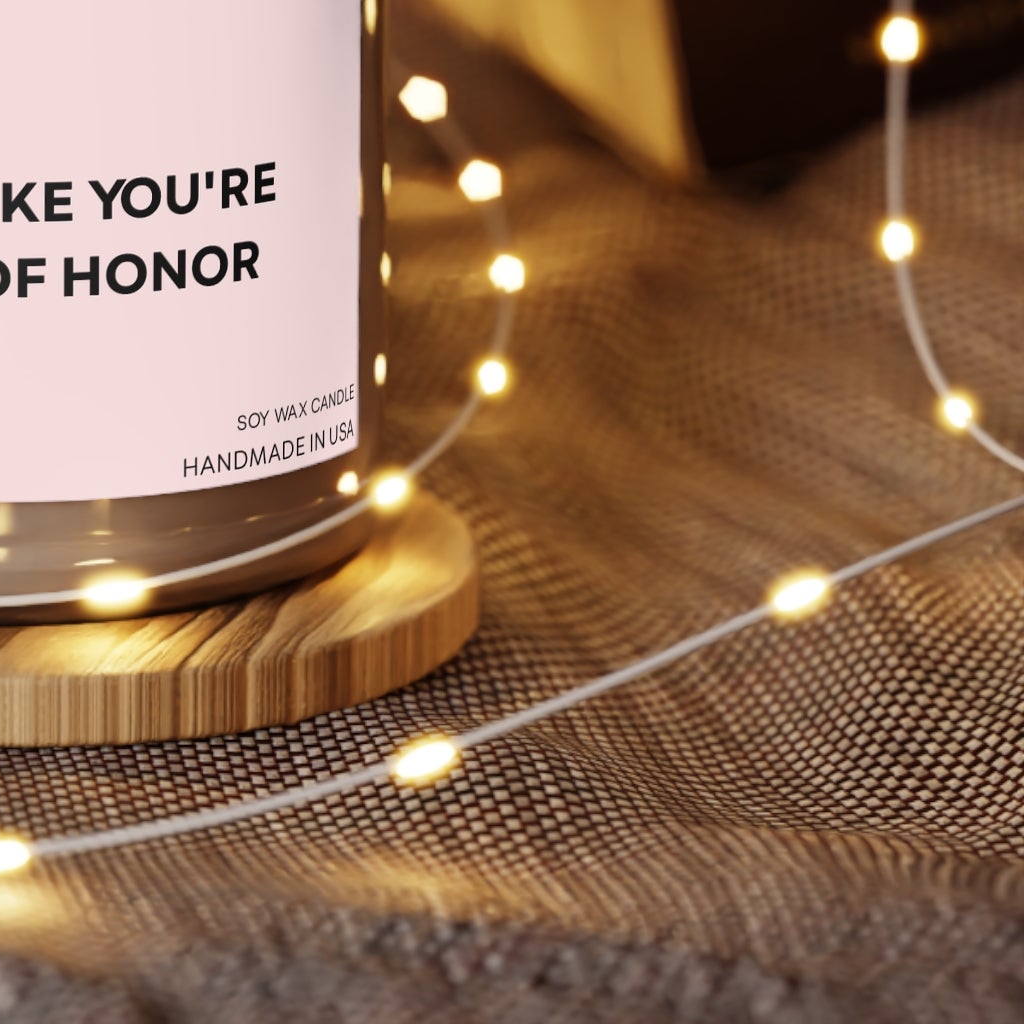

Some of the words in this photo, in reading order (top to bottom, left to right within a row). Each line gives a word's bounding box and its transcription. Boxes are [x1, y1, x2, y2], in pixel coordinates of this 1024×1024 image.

[88, 161, 277, 221] YOU'RE
[63, 240, 260, 298] HONOR
[236, 410, 270, 432] SOY
[274, 400, 308, 423] WAX
[310, 383, 355, 414] CANDLE
[183, 435, 305, 478] HANDMADE
[309, 429, 325, 453] IN
[328, 418, 354, 446] USA
